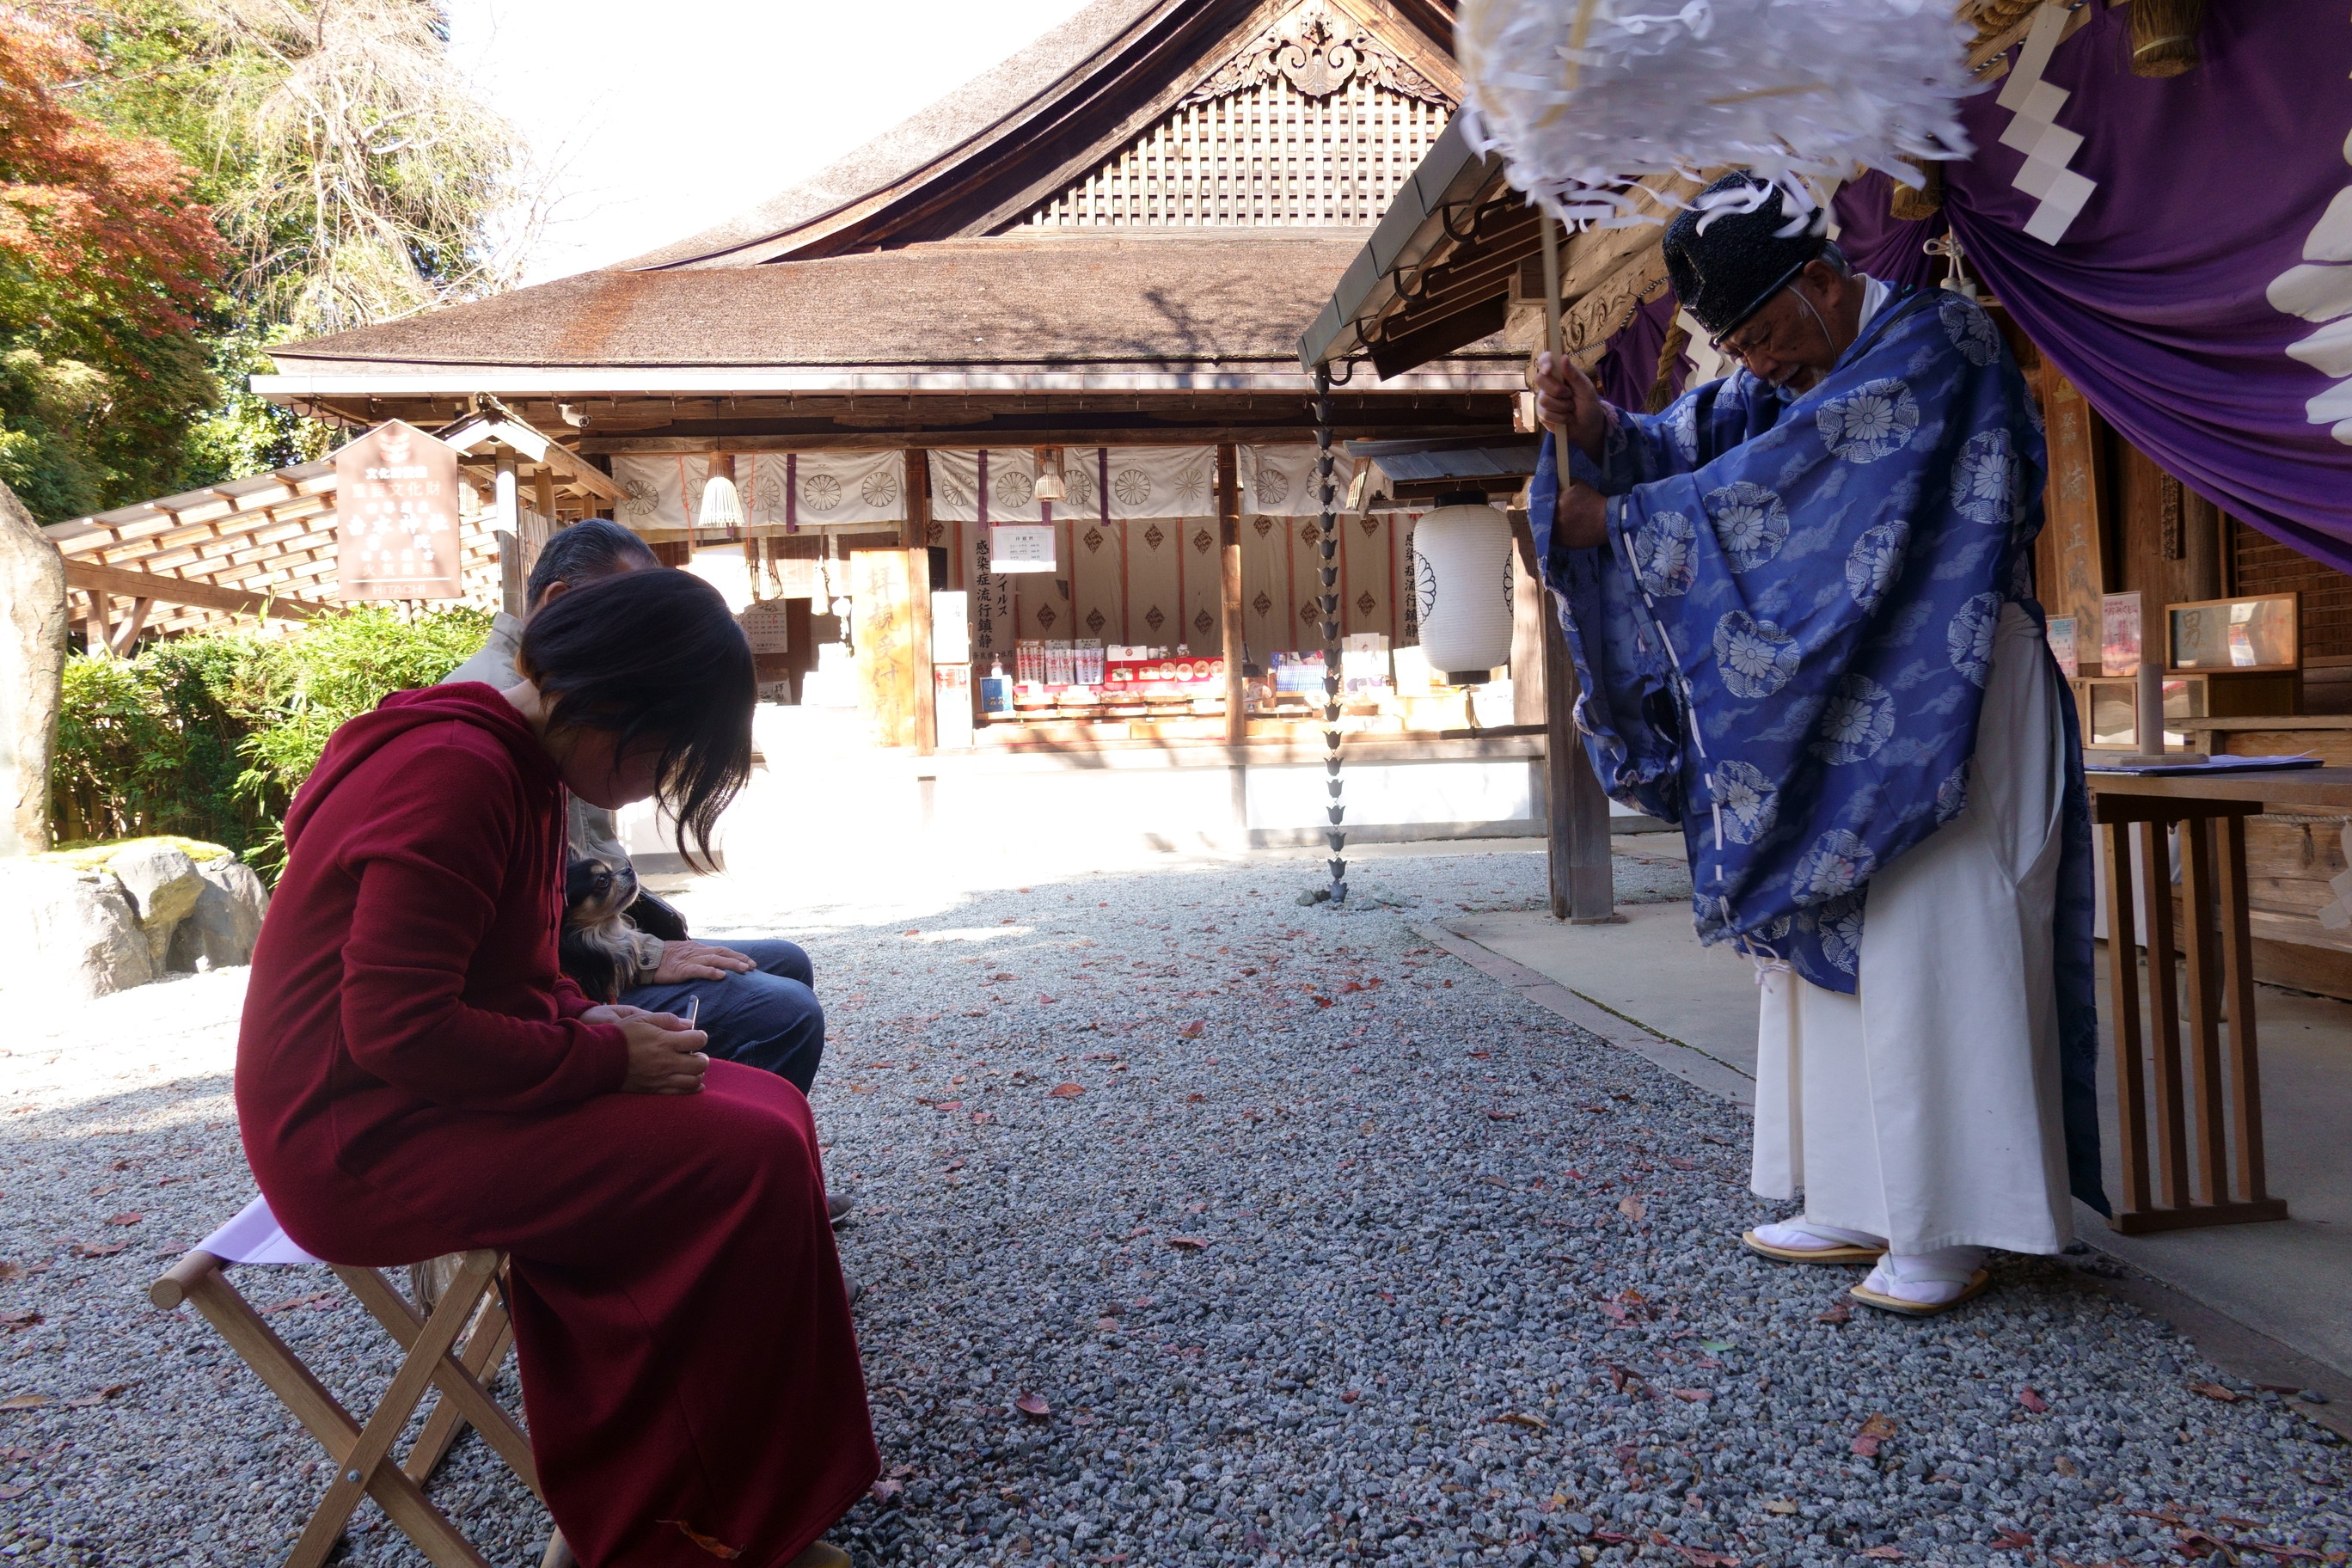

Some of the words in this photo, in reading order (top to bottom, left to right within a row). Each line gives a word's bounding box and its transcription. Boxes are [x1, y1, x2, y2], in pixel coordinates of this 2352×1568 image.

[352, 481, 441, 498] 重要文化財
[362, 563, 435, 576] 火気厳禁
[372, 585, 426, 595] HITACHI
[976, 539, 993, 649] 感染症流行鎮静
[2182, 610, 2202, 649] 男
